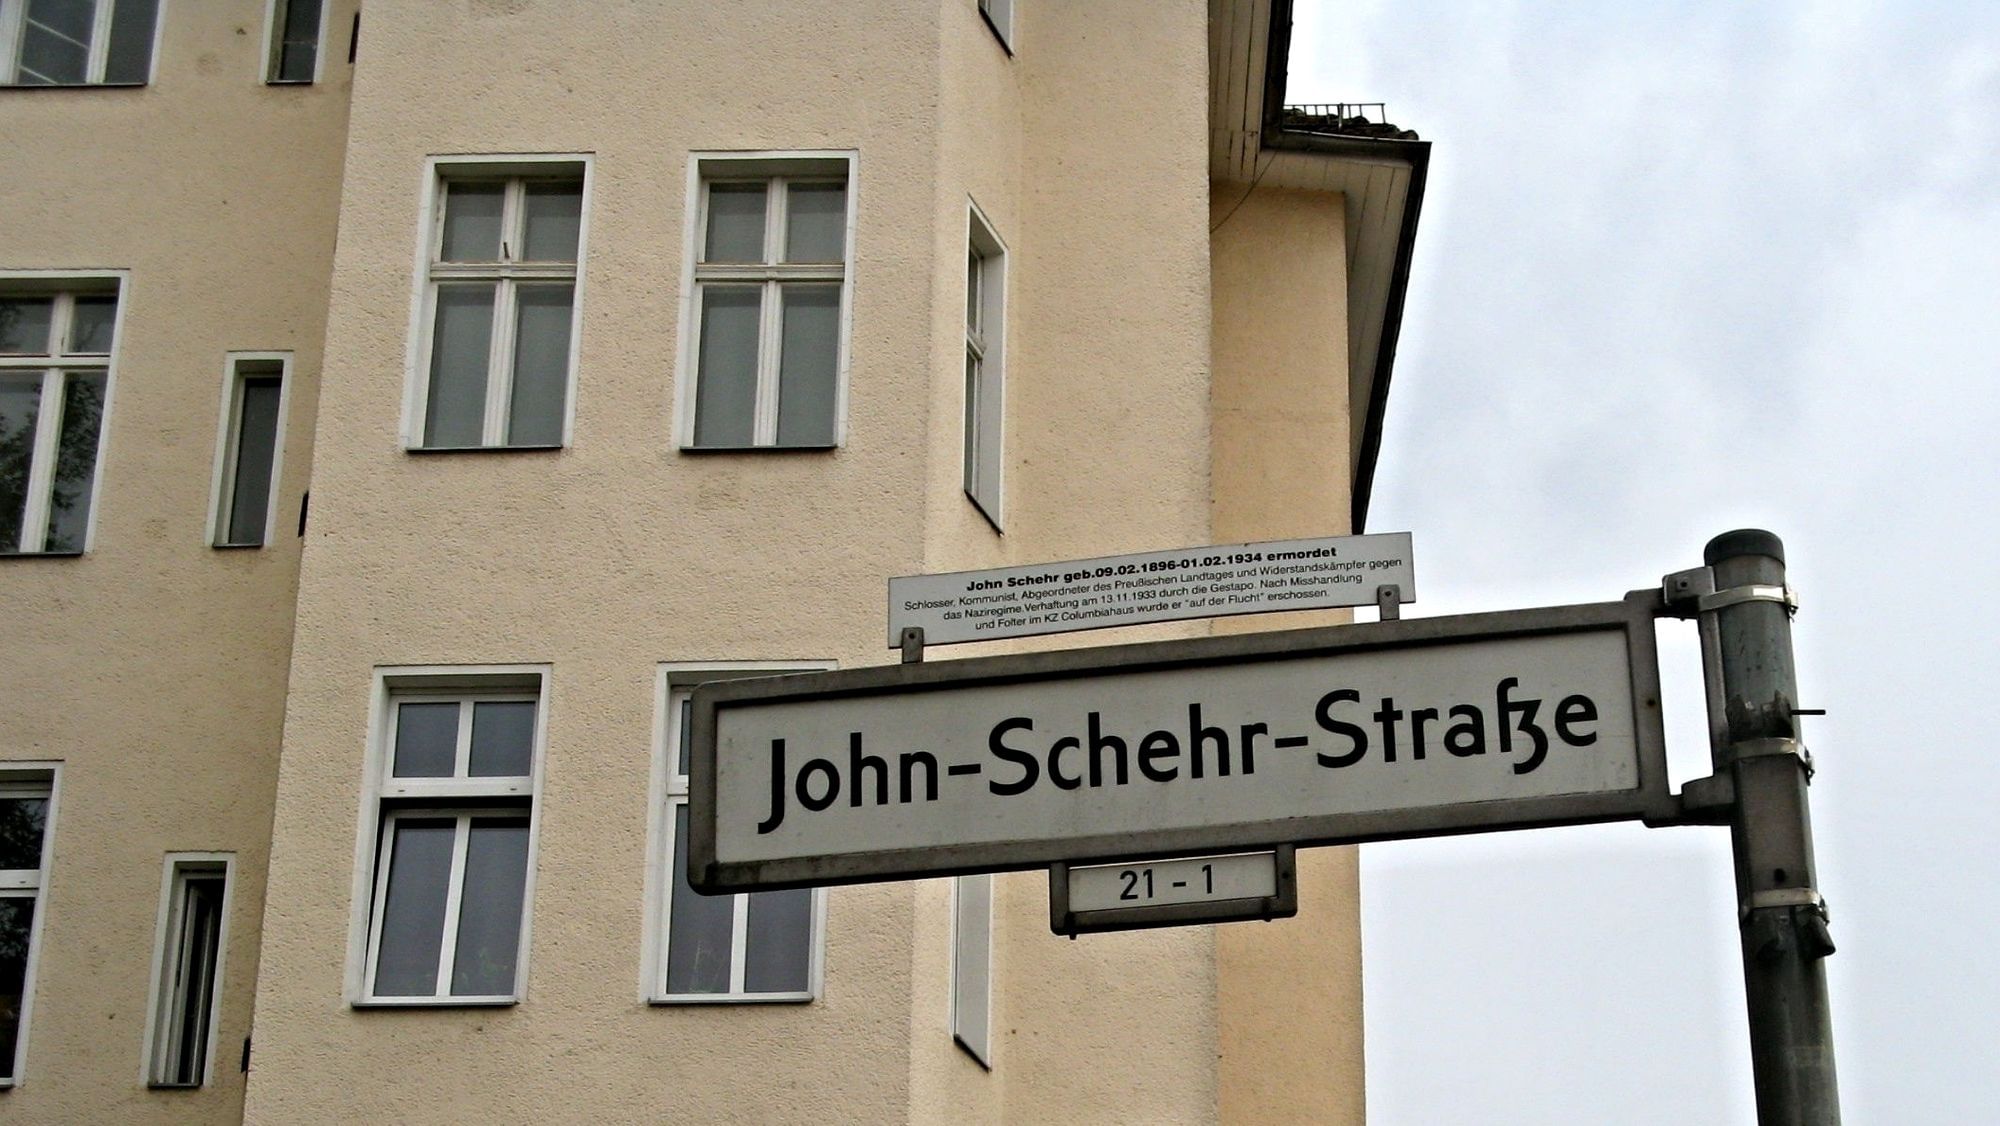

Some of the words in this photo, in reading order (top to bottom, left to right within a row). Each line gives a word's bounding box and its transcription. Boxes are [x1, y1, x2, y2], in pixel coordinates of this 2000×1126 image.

[904, 600, 956, 611] Schlosser,
[959, 592, 1018, 606] Kommunist,
[1021, 583, 1090, 600] Abgeordneter
[1093, 582, 1111, 592] des
[1114, 575, 1178, 590] Preußischen
[1180, 571, 1234, 583] Landtages
[1236, 567, 1257, 578] und
[1260, 560, 1366, 575] Widerstandskämpfer
[1368, 558, 1402, 570] gegen
[966, 579, 1003, 591] John
[1007, 573, 1059, 587] Schehr
[1267, 547, 1337, 561] ermordet
[943, 610, 962, 620] das
[1081, 598, 1098, 606] am
[1159, 586, 1189, 597] durch
[1191, 584, 1208, 594] die
[1210, 582, 1257, 593] Gestapo.
[1260, 577, 1287, 588] Nach
[1290, 573, 1363, 586] Misshandlung
[975, 619, 995, 630] und
[998, 617, 1026, 628] Folter
[1029, 615, 1042, 625] im
[1044, 613, 1058, 622] KZ
[1061, 606, 1135, 621] Columbiahaus
[1137, 601, 1169, 612] wurde
[1208, 595, 1225, 606] der
[1267, 588, 1330, 601] erschossen.
[757, 677, 1600, 834] John-Schehr-Straße
[1119, 868, 1153, 901] 21
[1202, 864, 1213, 894] 1
